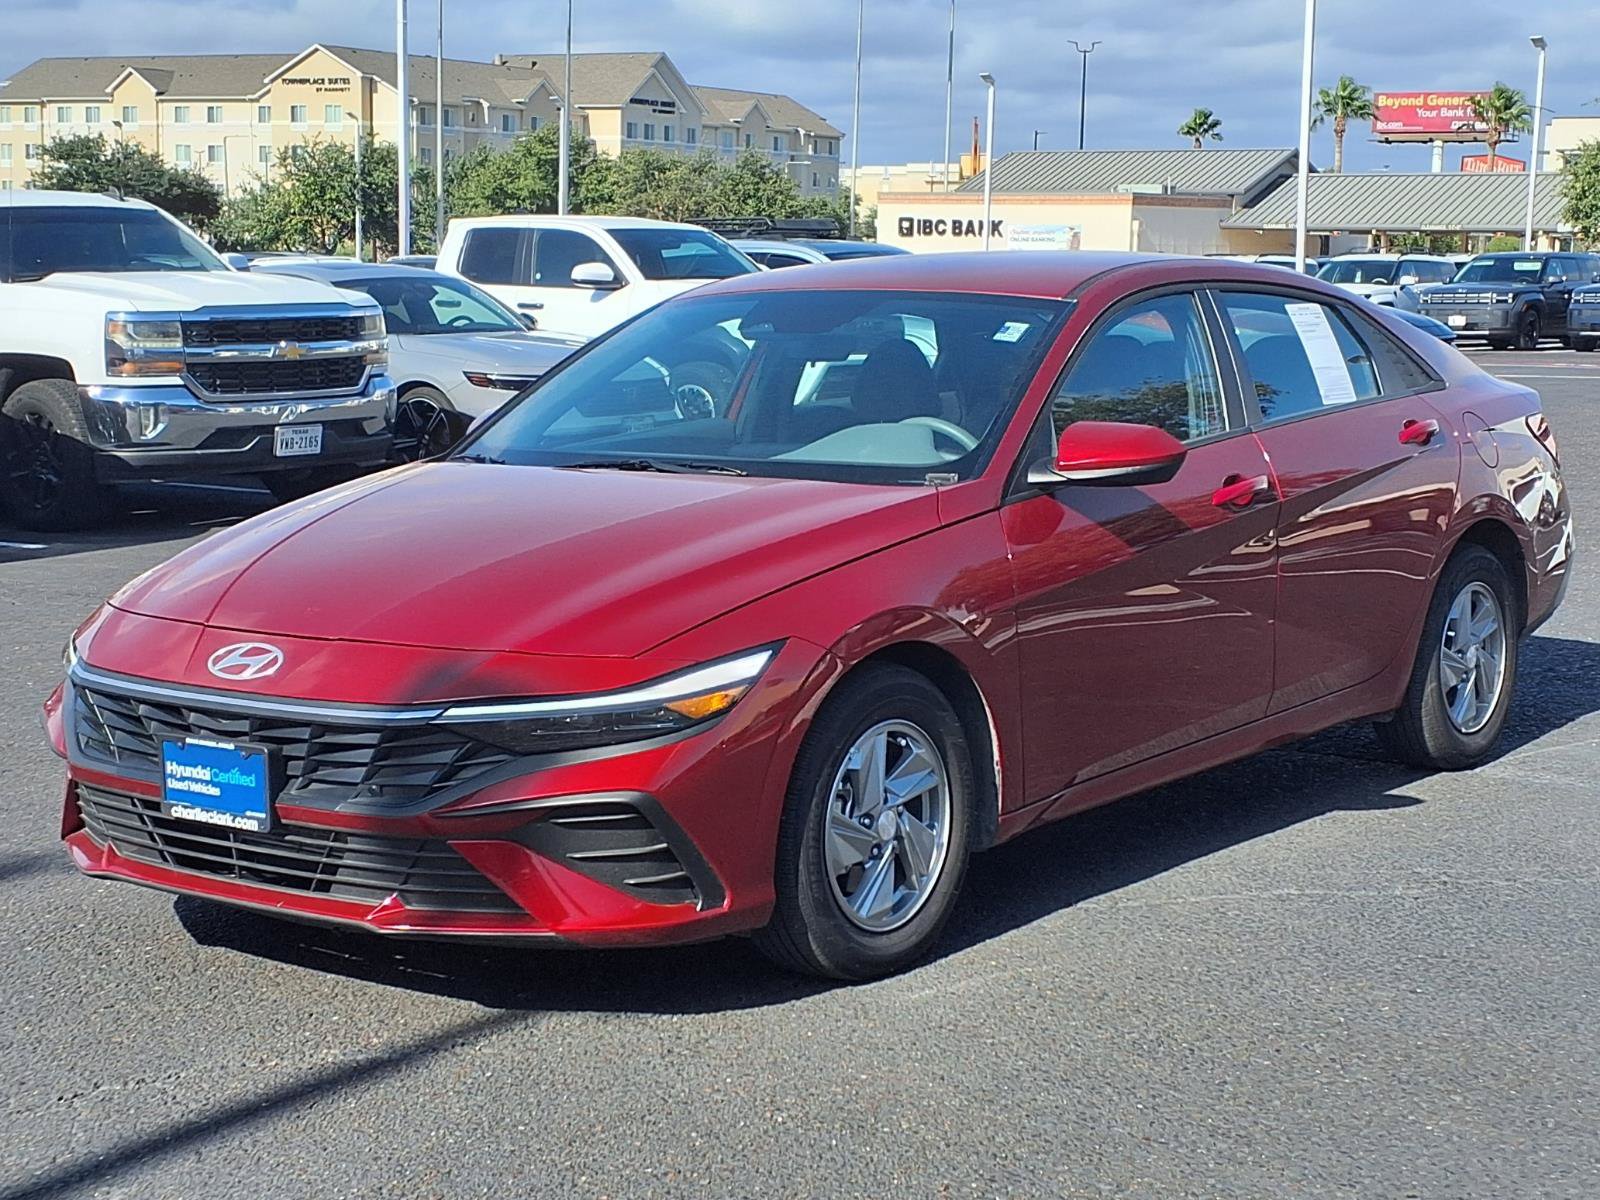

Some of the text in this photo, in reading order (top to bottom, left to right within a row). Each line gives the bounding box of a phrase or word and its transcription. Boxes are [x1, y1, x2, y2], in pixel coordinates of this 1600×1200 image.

[1378, 95, 1424, 108] Beyond
[1416, 107, 1438, 117] Your
[1440, 106, 1464, 117] Bank
[917, 219, 947, 237] IBC
[166, 760, 256, 787] Hyundai Certified
[171, 805, 259, 831] charlieclark.com
